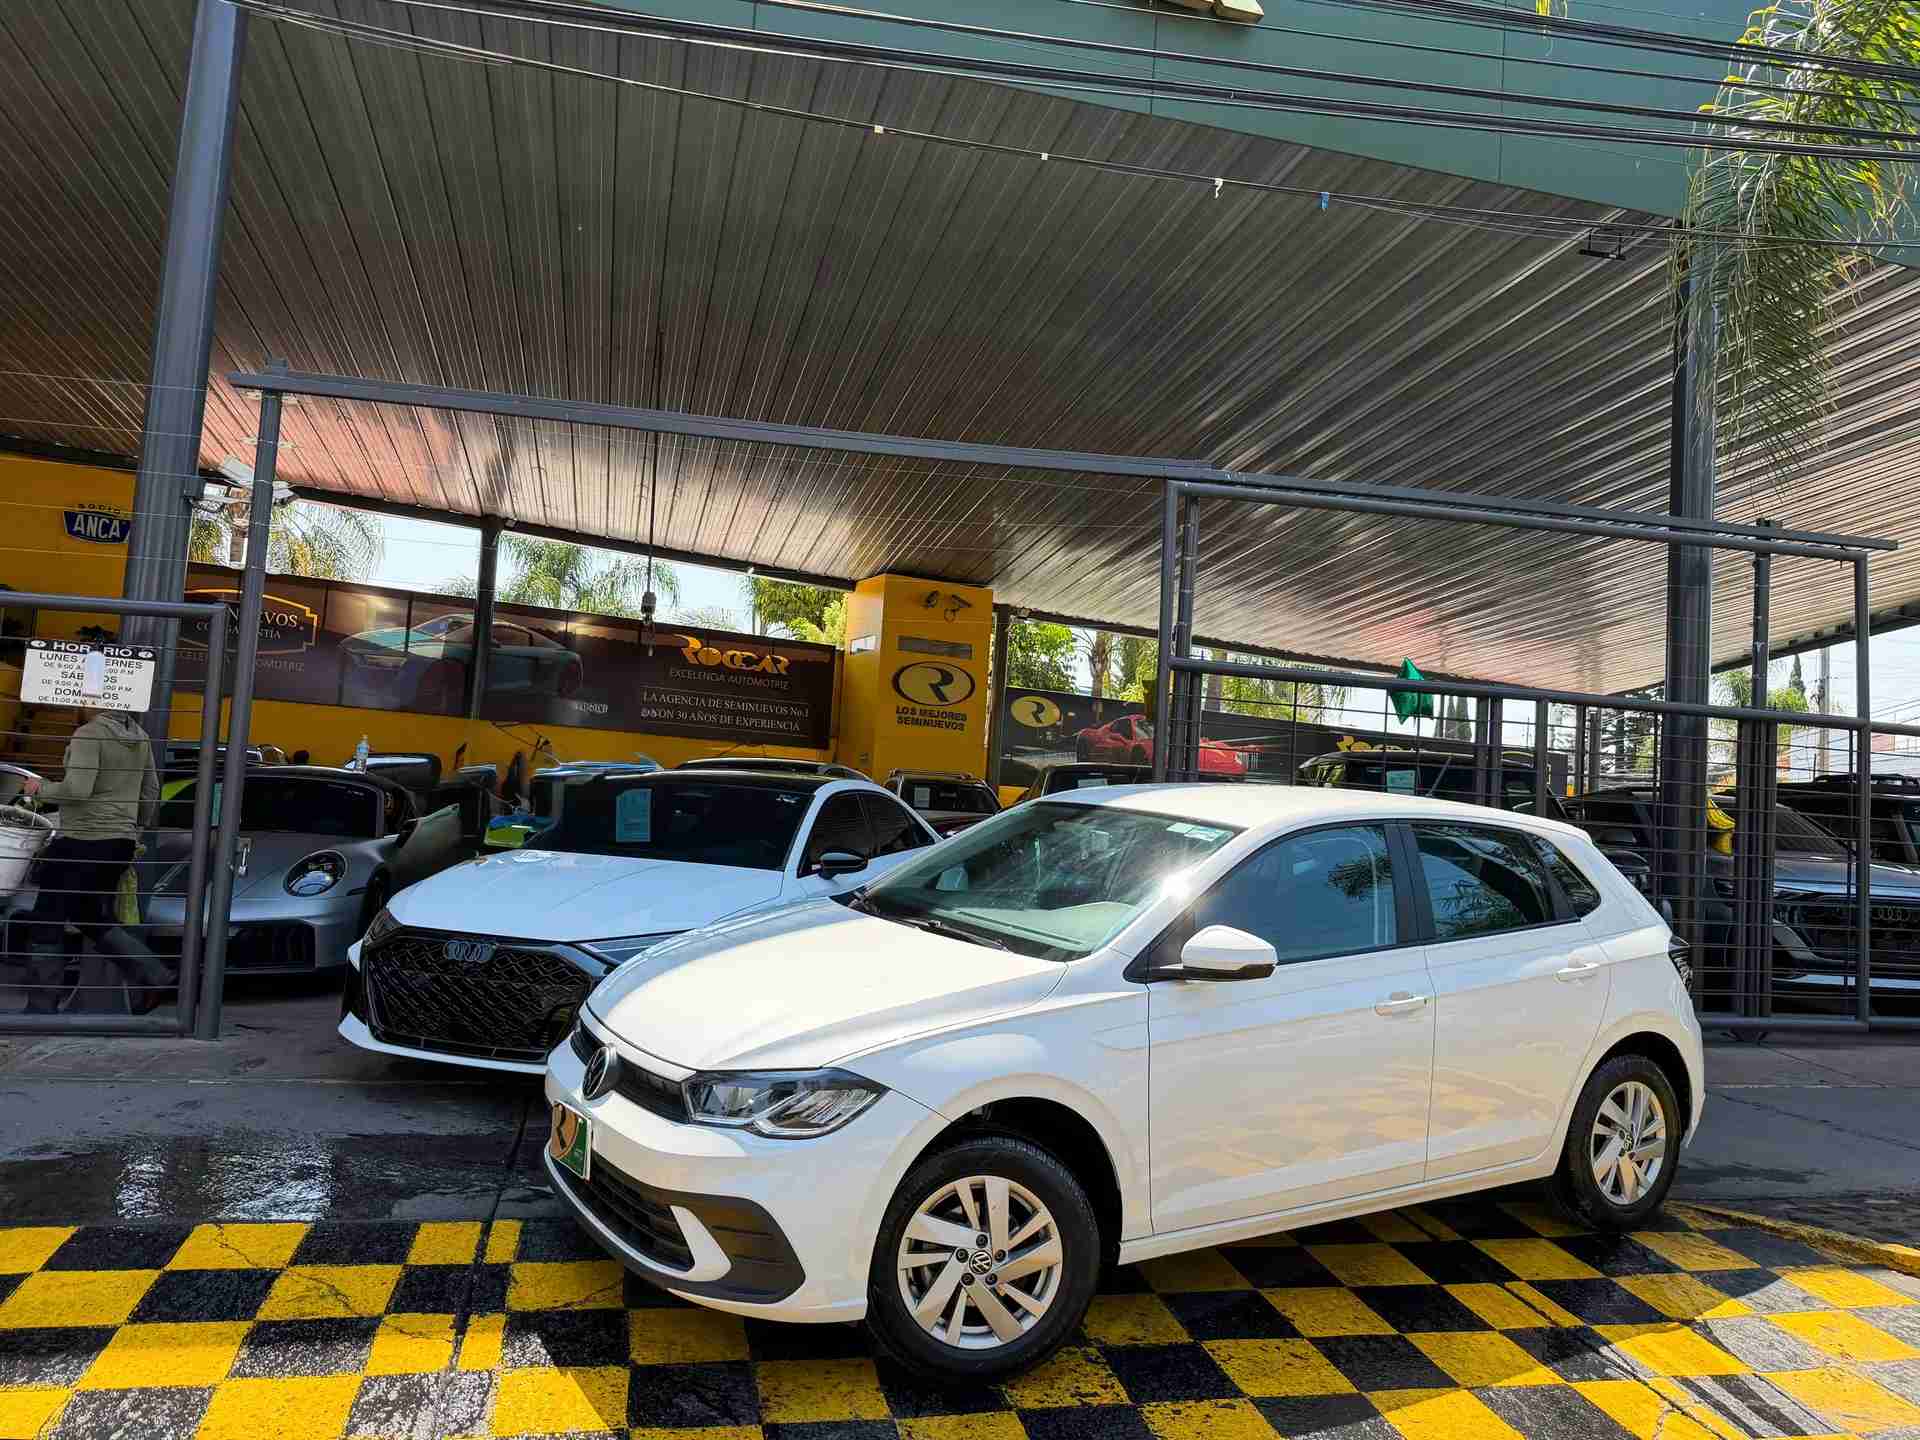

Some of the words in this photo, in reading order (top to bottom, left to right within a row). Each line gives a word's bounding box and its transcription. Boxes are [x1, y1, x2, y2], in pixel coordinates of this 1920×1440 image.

[72, 513, 121, 539] ANCA
[39, 651, 78, 663] LUNES
[53, 640, 133, 657] HORRIO
[670, 666, 725, 683] EXCELENCIA
[727, 674, 790, 690] AUTOMOTRIZ
[642, 690, 658, 703] LA
[659, 693, 706, 707] AGENCIA
[707, 696, 722, 709] DE
[724, 700, 789, 715] SEMINUEVOS
[675, 710, 688, 721] 30
[688, 710, 717, 723] AÑOS
[719, 714, 733, 726] DE
[735, 715, 801, 731] EXPERIENCIA
[895, 705, 918, 716] LOS
[919, 708, 968, 722] MEJORES
[896, 715, 966, 732] SEMINUEVOS
